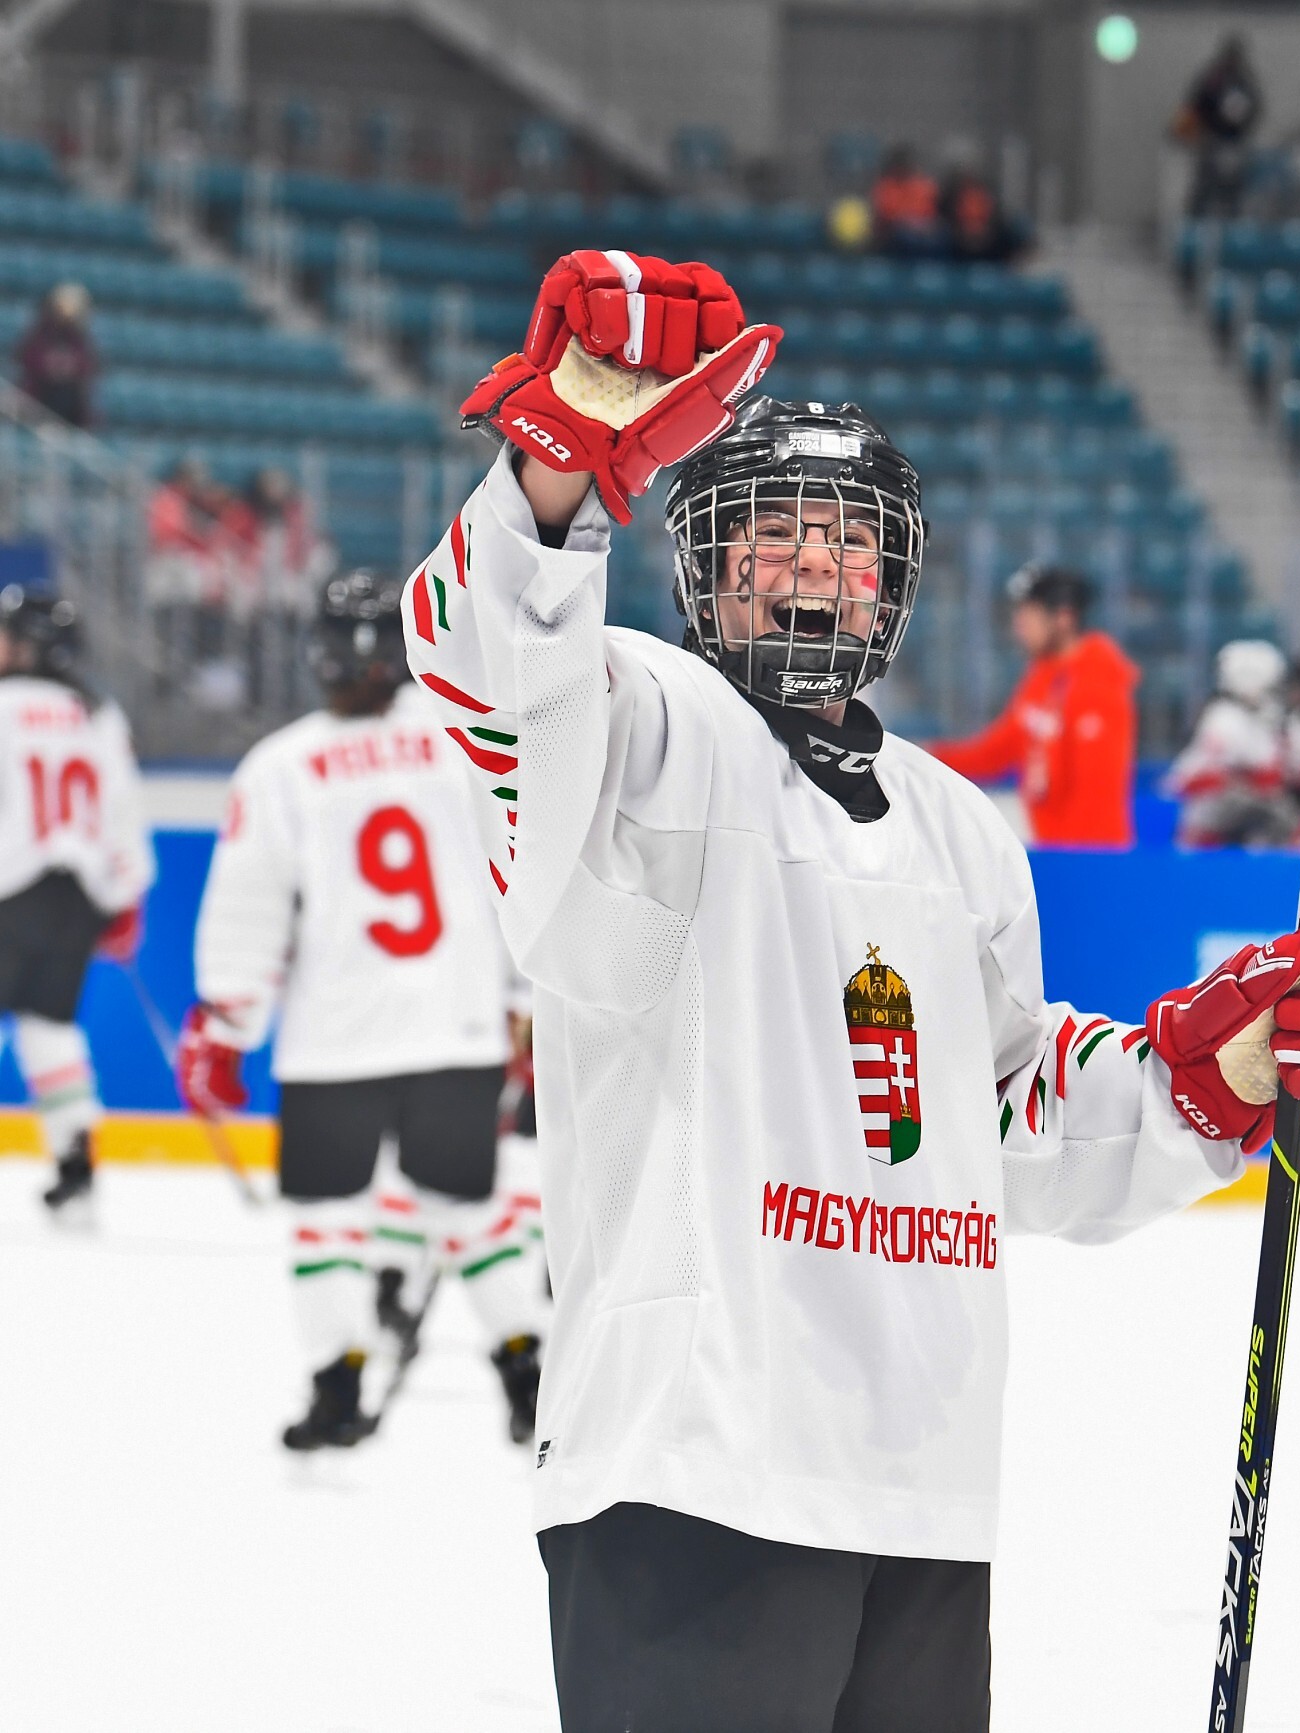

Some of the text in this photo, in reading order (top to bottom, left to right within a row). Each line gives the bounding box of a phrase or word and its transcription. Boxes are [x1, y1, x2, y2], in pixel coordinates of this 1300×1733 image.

[511, 416, 572, 463] CCM
[788, 440, 820, 451] 2024
[806, 733, 877, 774] CC
[27, 754, 99, 842] 10
[356, 804, 443, 959] 9
[1174, 1093, 1221, 1138] CCM
[1239, 1323, 1265, 1464] SUPER
[1215, 1468, 1257, 1677] TACKS
[1248, 1495, 1267, 1586] TACKS
[1245, 1587, 1257, 1645] SUPER
